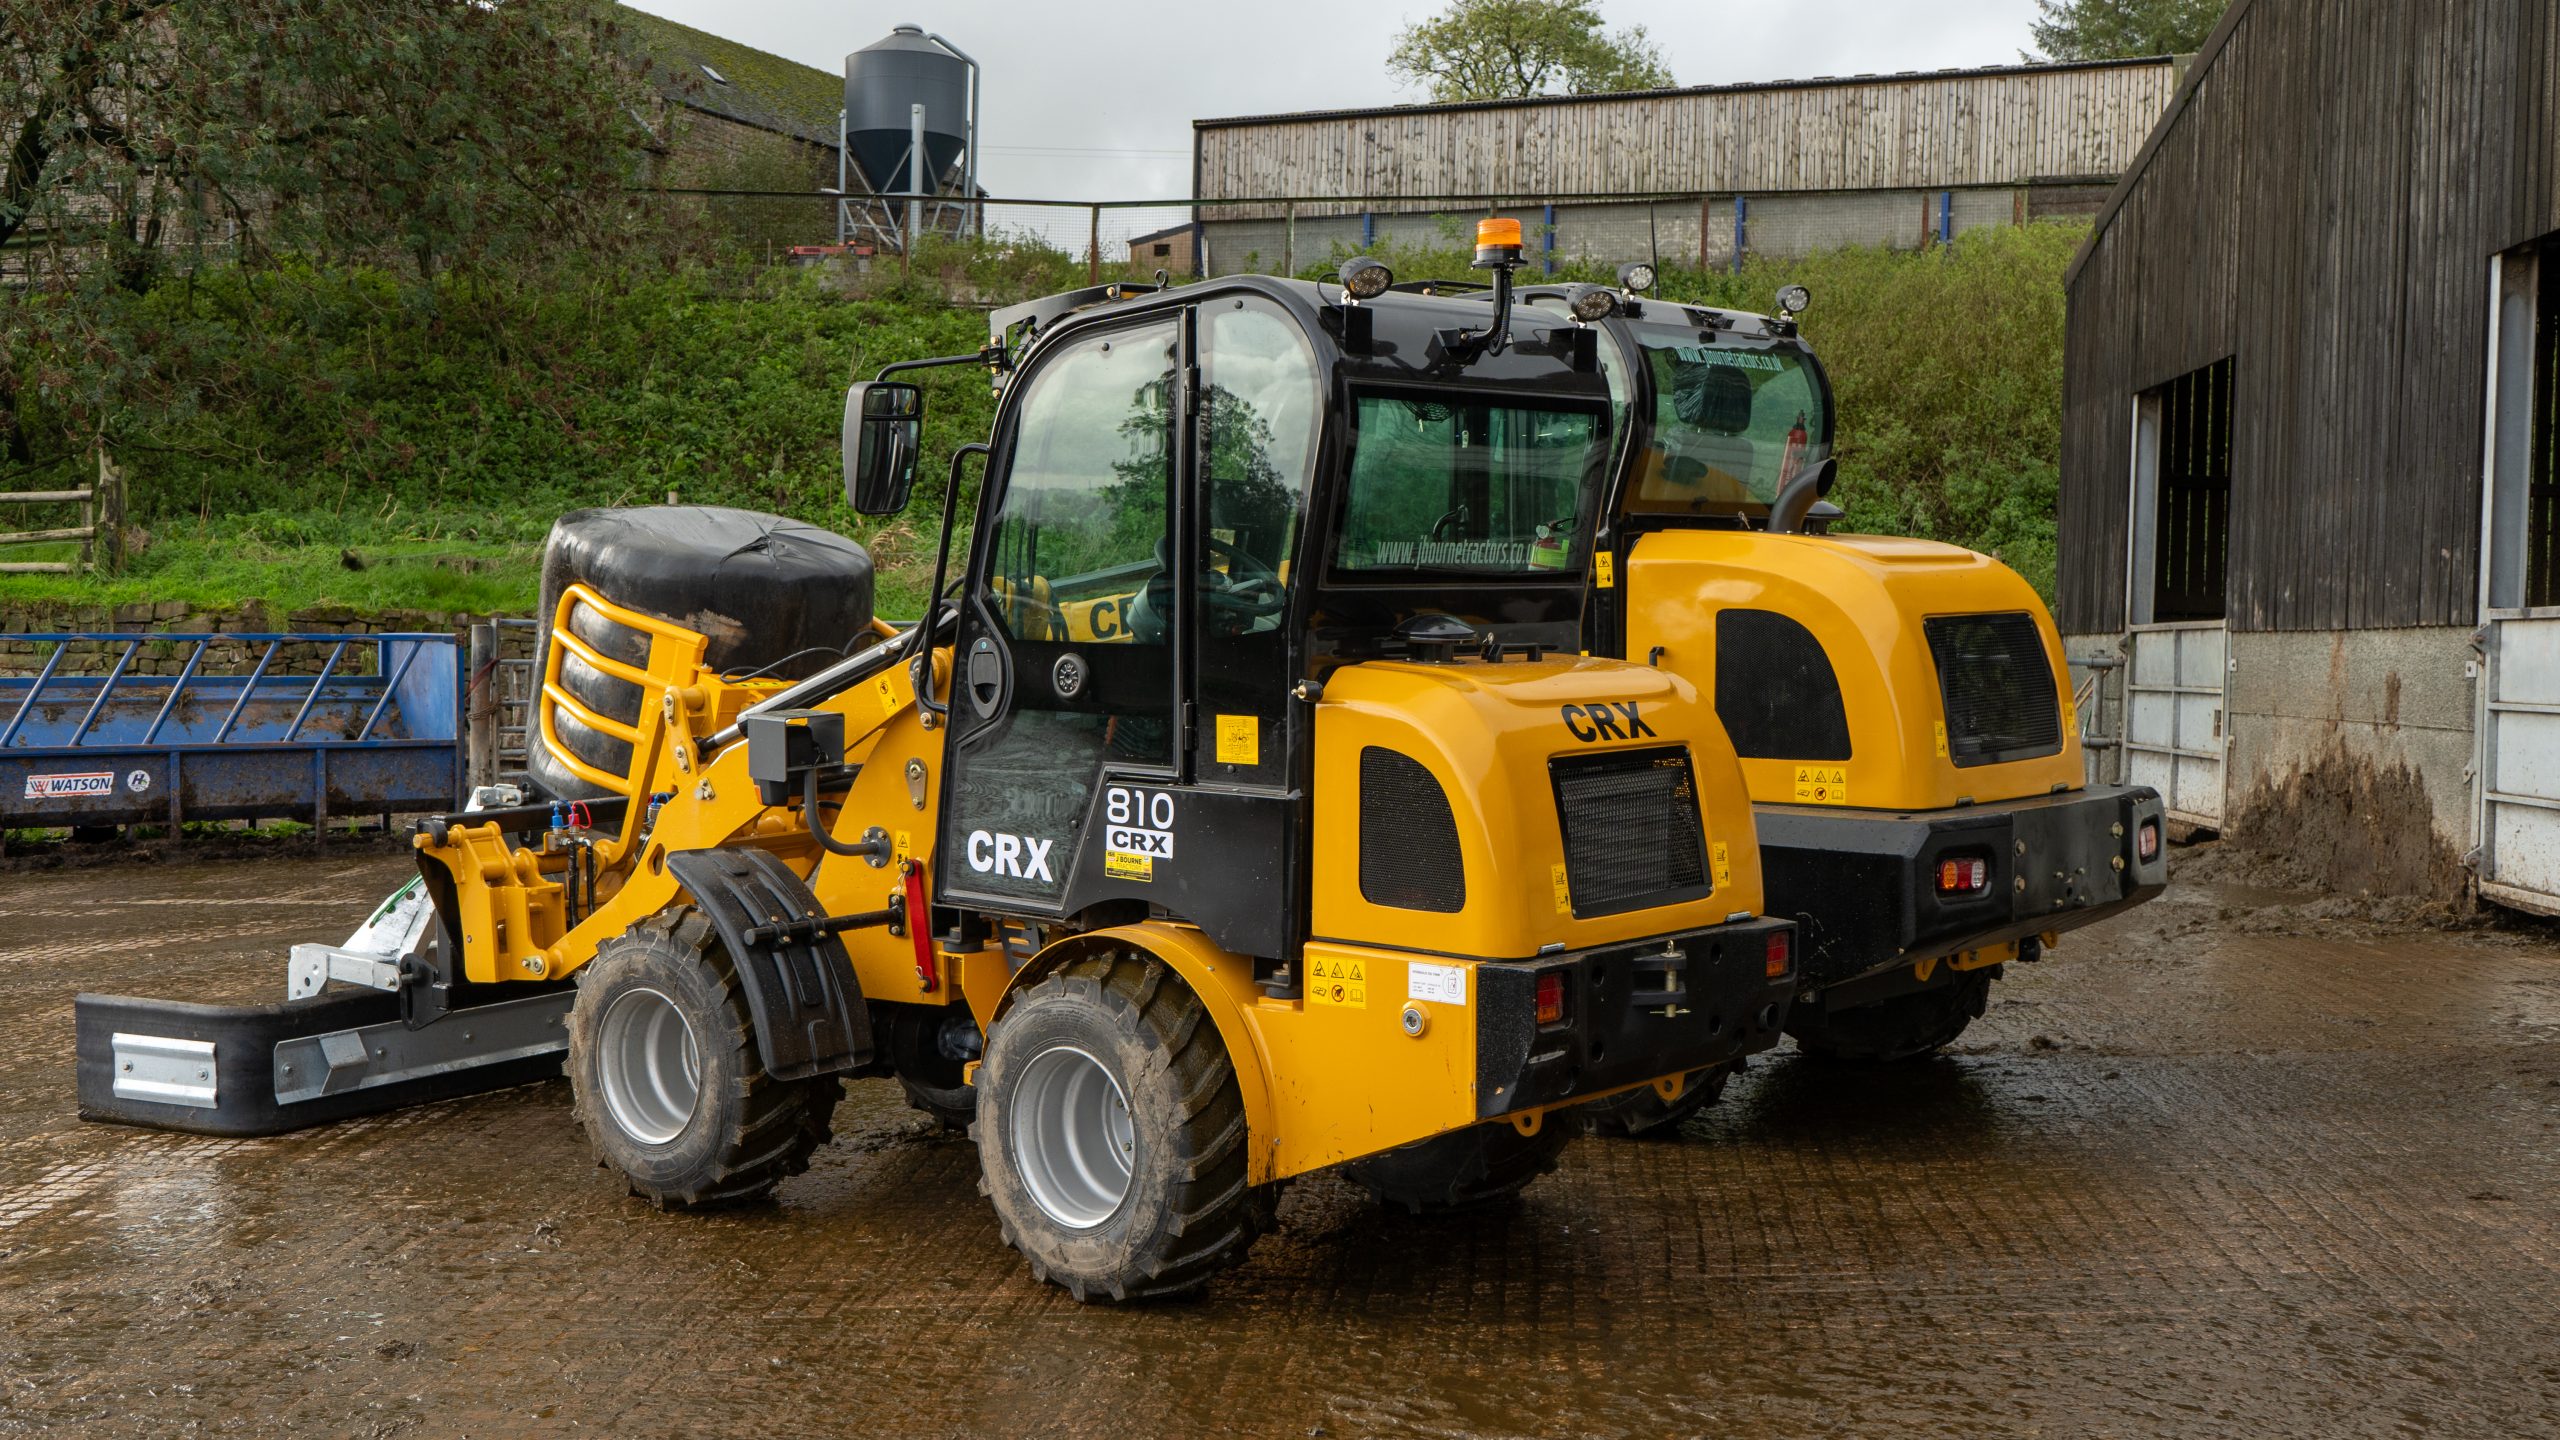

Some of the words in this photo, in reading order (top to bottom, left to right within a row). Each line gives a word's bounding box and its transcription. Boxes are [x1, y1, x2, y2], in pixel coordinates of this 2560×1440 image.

[1561, 701, 1657, 743] CRX
[51, 777, 111, 791] WATSON
[1107, 788, 1174, 829] 810
[967, 830, 1053, 882] CRX
[1112, 830, 1167, 854] CRX
[1120, 856, 1142, 865] BOURNE
